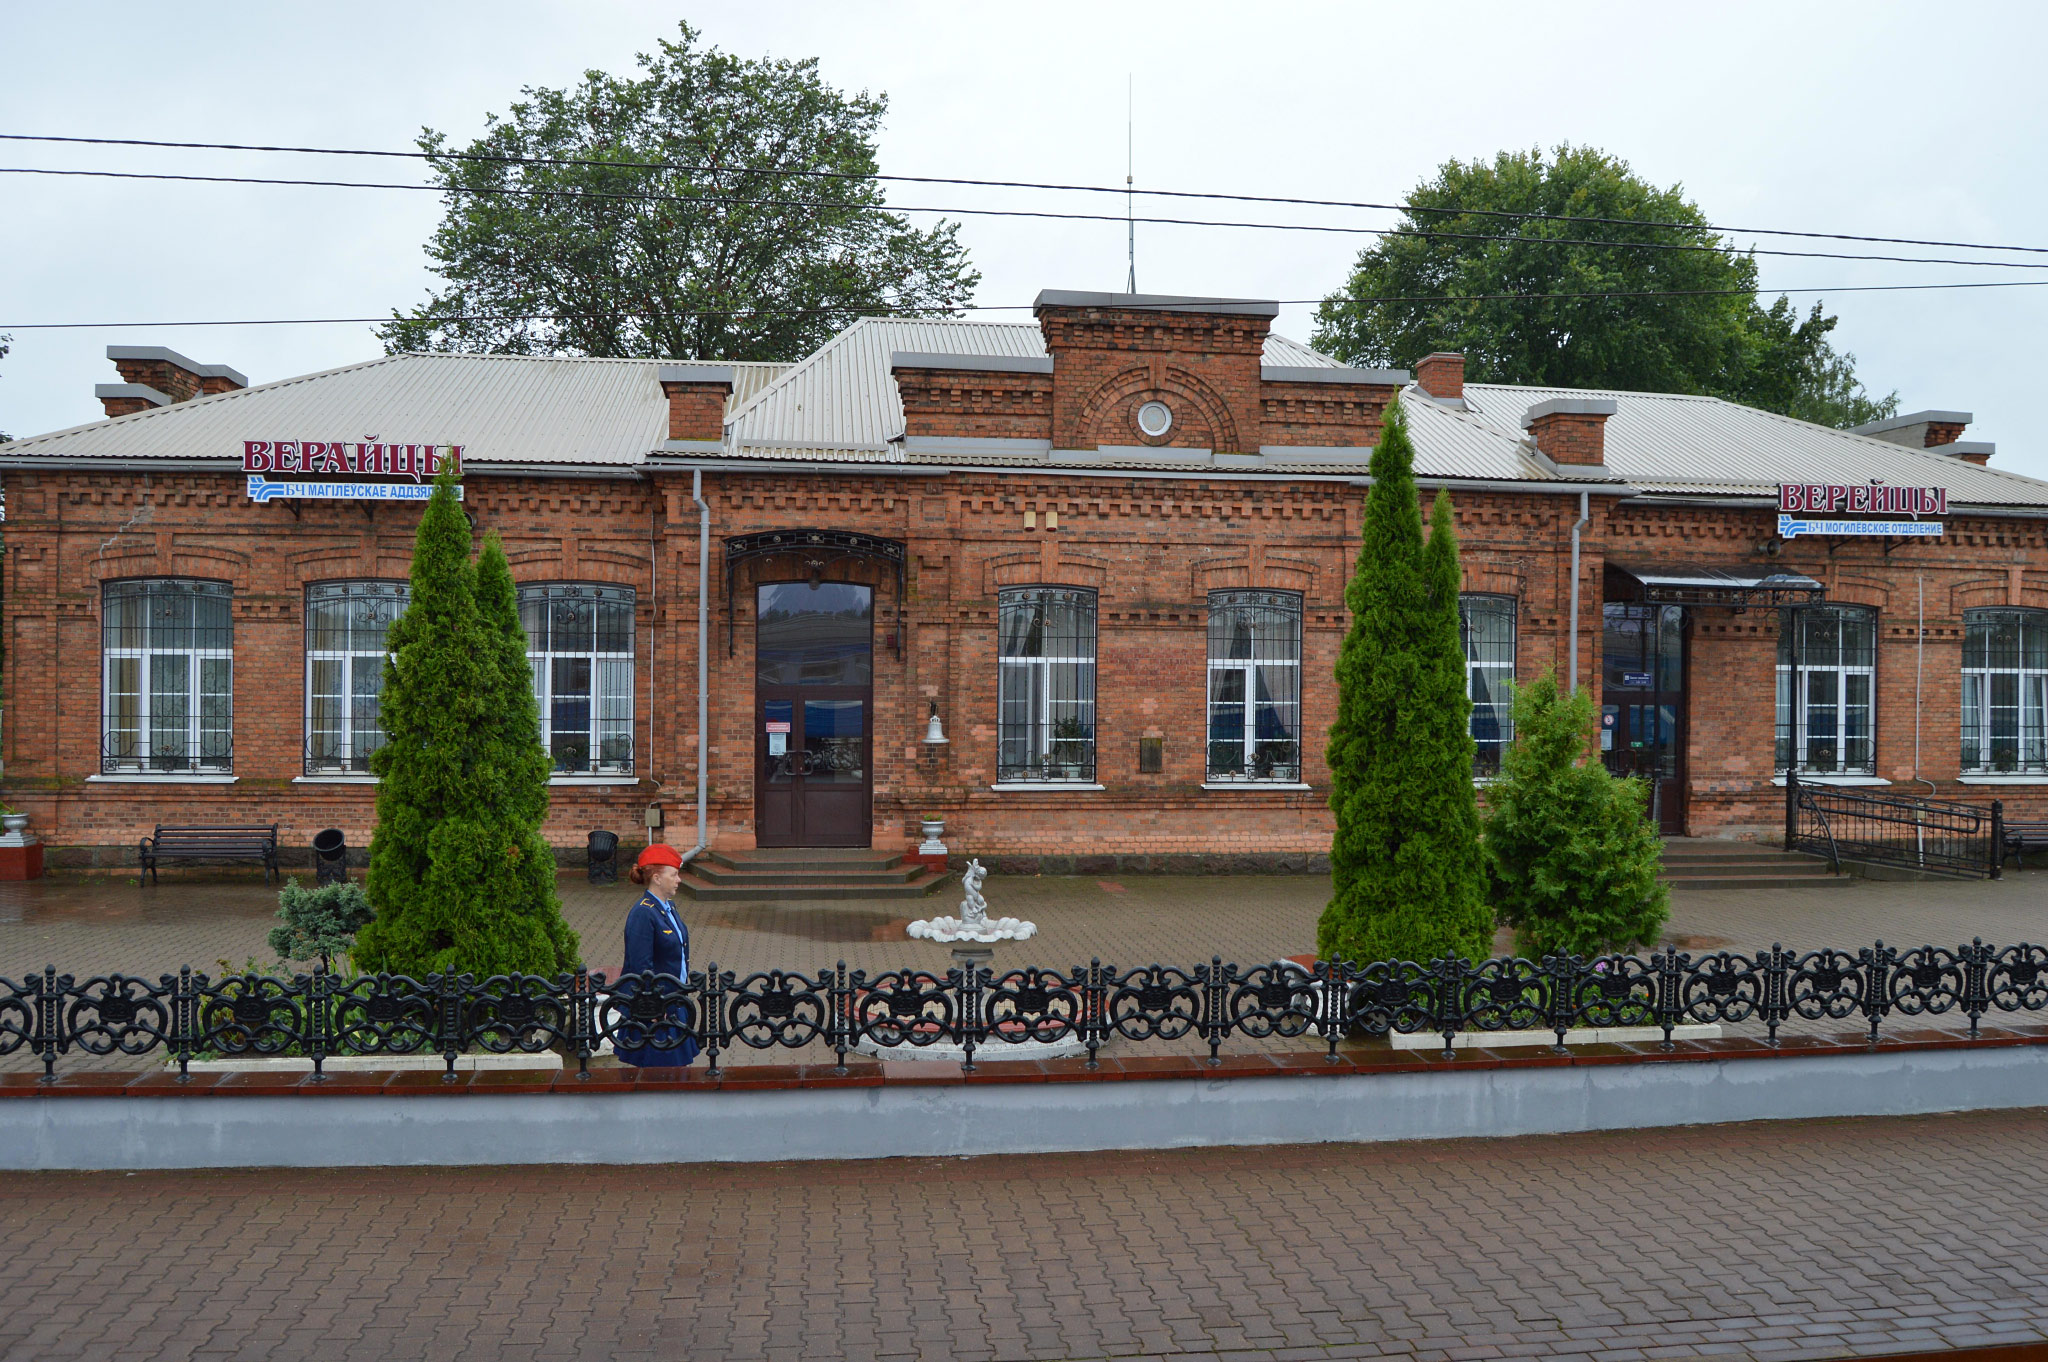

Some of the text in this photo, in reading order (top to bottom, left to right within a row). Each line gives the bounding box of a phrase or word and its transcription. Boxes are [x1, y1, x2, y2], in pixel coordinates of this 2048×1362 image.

[242, 433, 464, 484] ВЕРАЙЦЫ
[286, 484, 305, 496] БЧ
[1778, 479, 1949, 521] ВЕРЕЙЦЫ
[1808, 522, 1824, 533] БЧ
[1891, 523, 1943, 534] ОТДЕЛЕНИЕ
